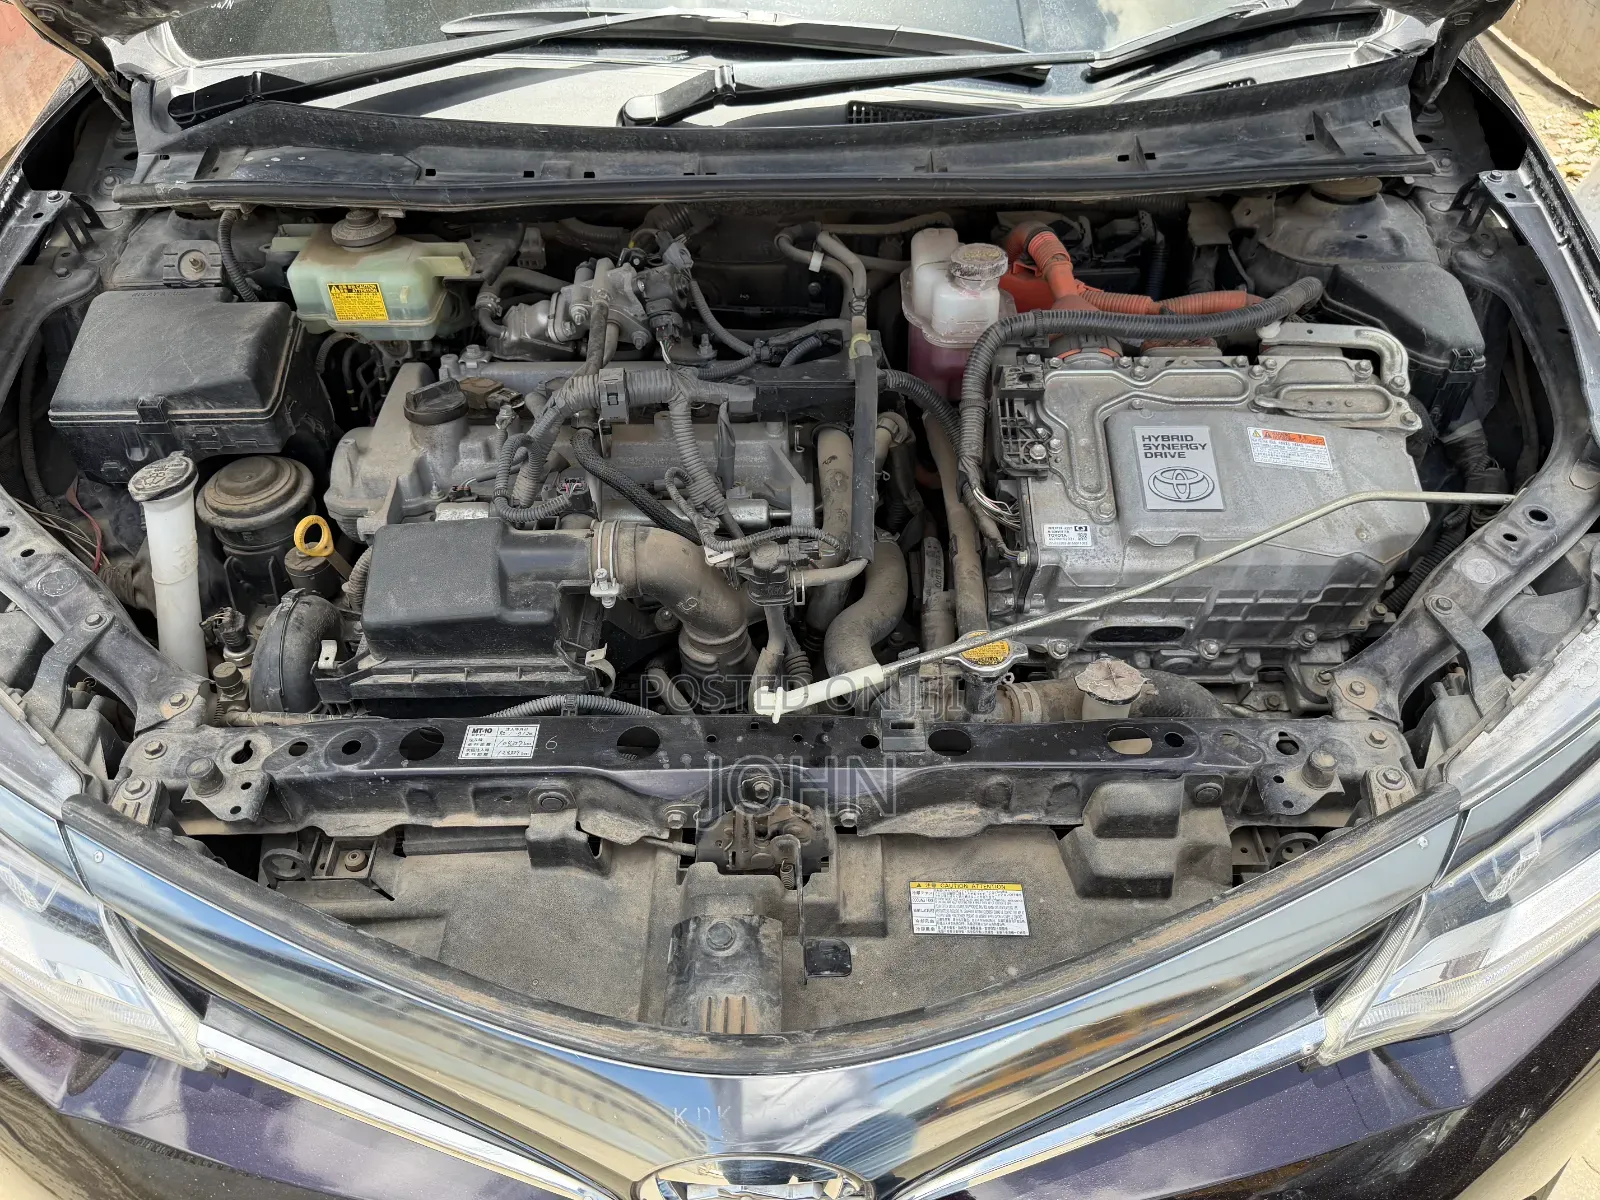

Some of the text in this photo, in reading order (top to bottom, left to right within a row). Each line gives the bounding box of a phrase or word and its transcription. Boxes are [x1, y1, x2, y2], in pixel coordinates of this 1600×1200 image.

[1141, 434, 1194, 442] HYBRID
[1142, 442, 1208, 451] SYNERGY
[1143, 451, 1187, 459] DRIVE
